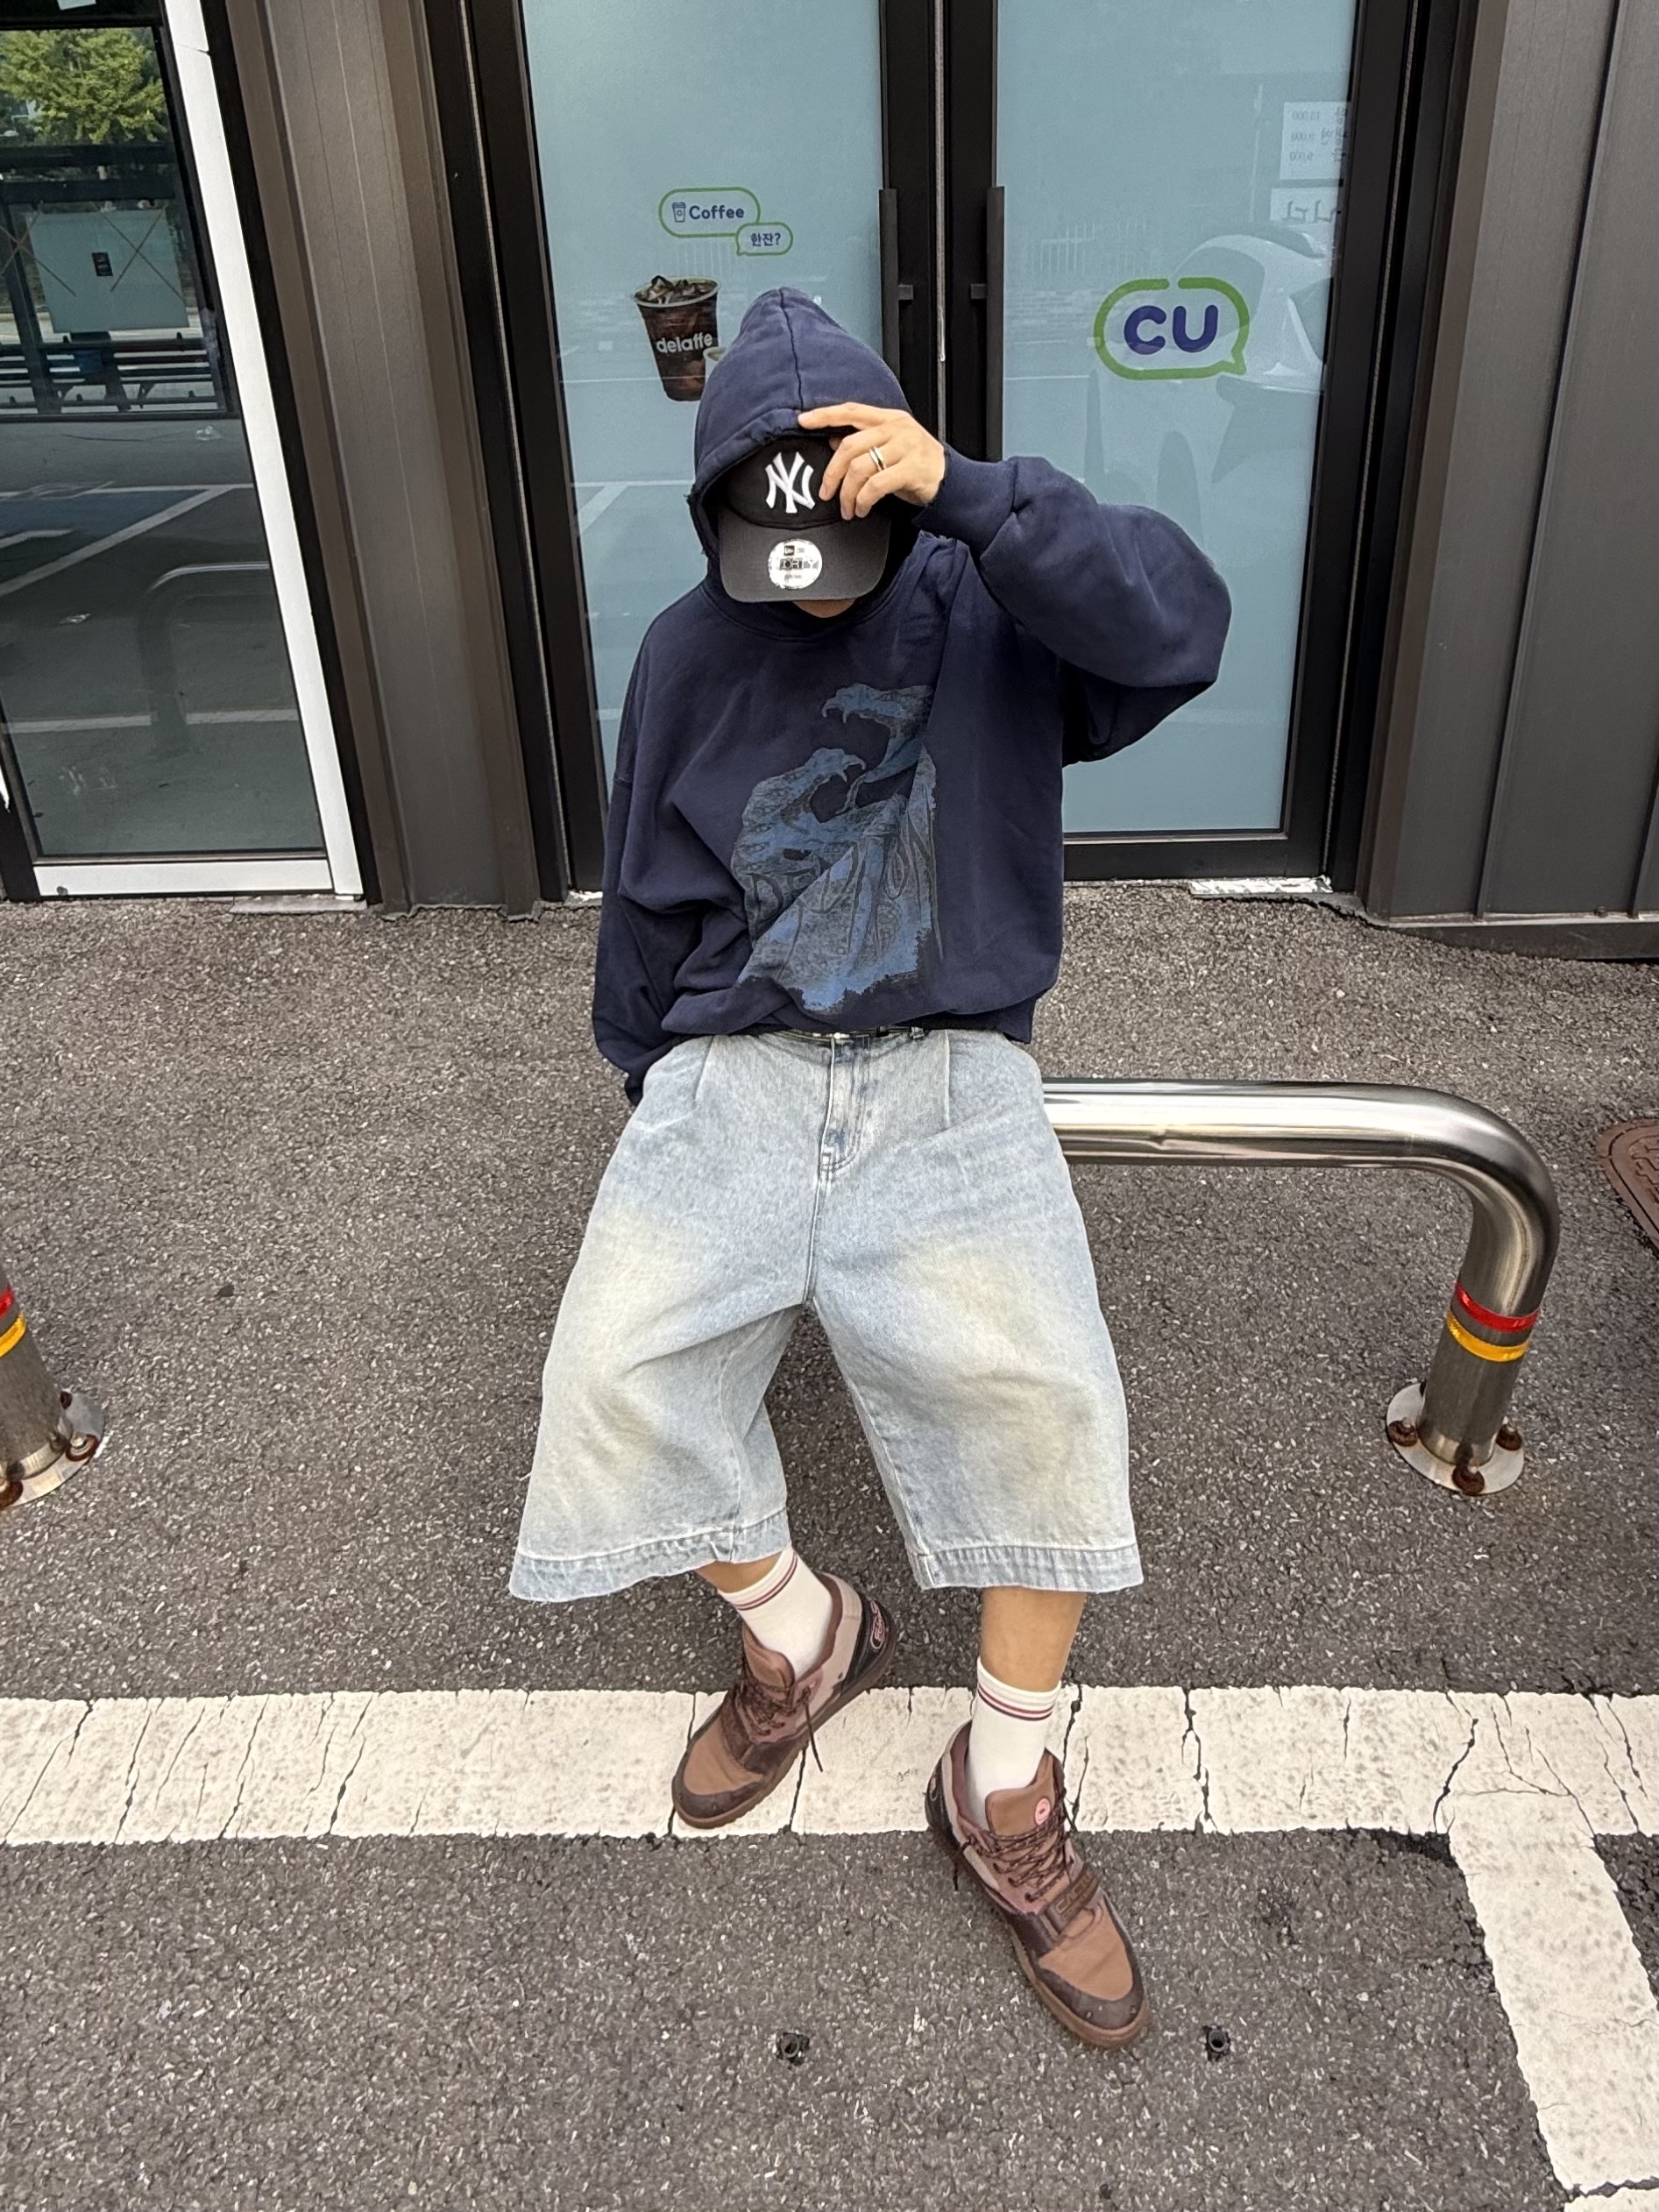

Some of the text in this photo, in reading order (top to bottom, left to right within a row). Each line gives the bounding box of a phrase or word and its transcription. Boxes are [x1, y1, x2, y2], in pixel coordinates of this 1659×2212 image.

[689, 204, 745, 220] Coffee
[750, 232, 781, 246] 한잔?
[1124, 304, 1219, 356] CU
[656, 332, 713, 354] delaffe
[765, 451, 815, 514] NY
